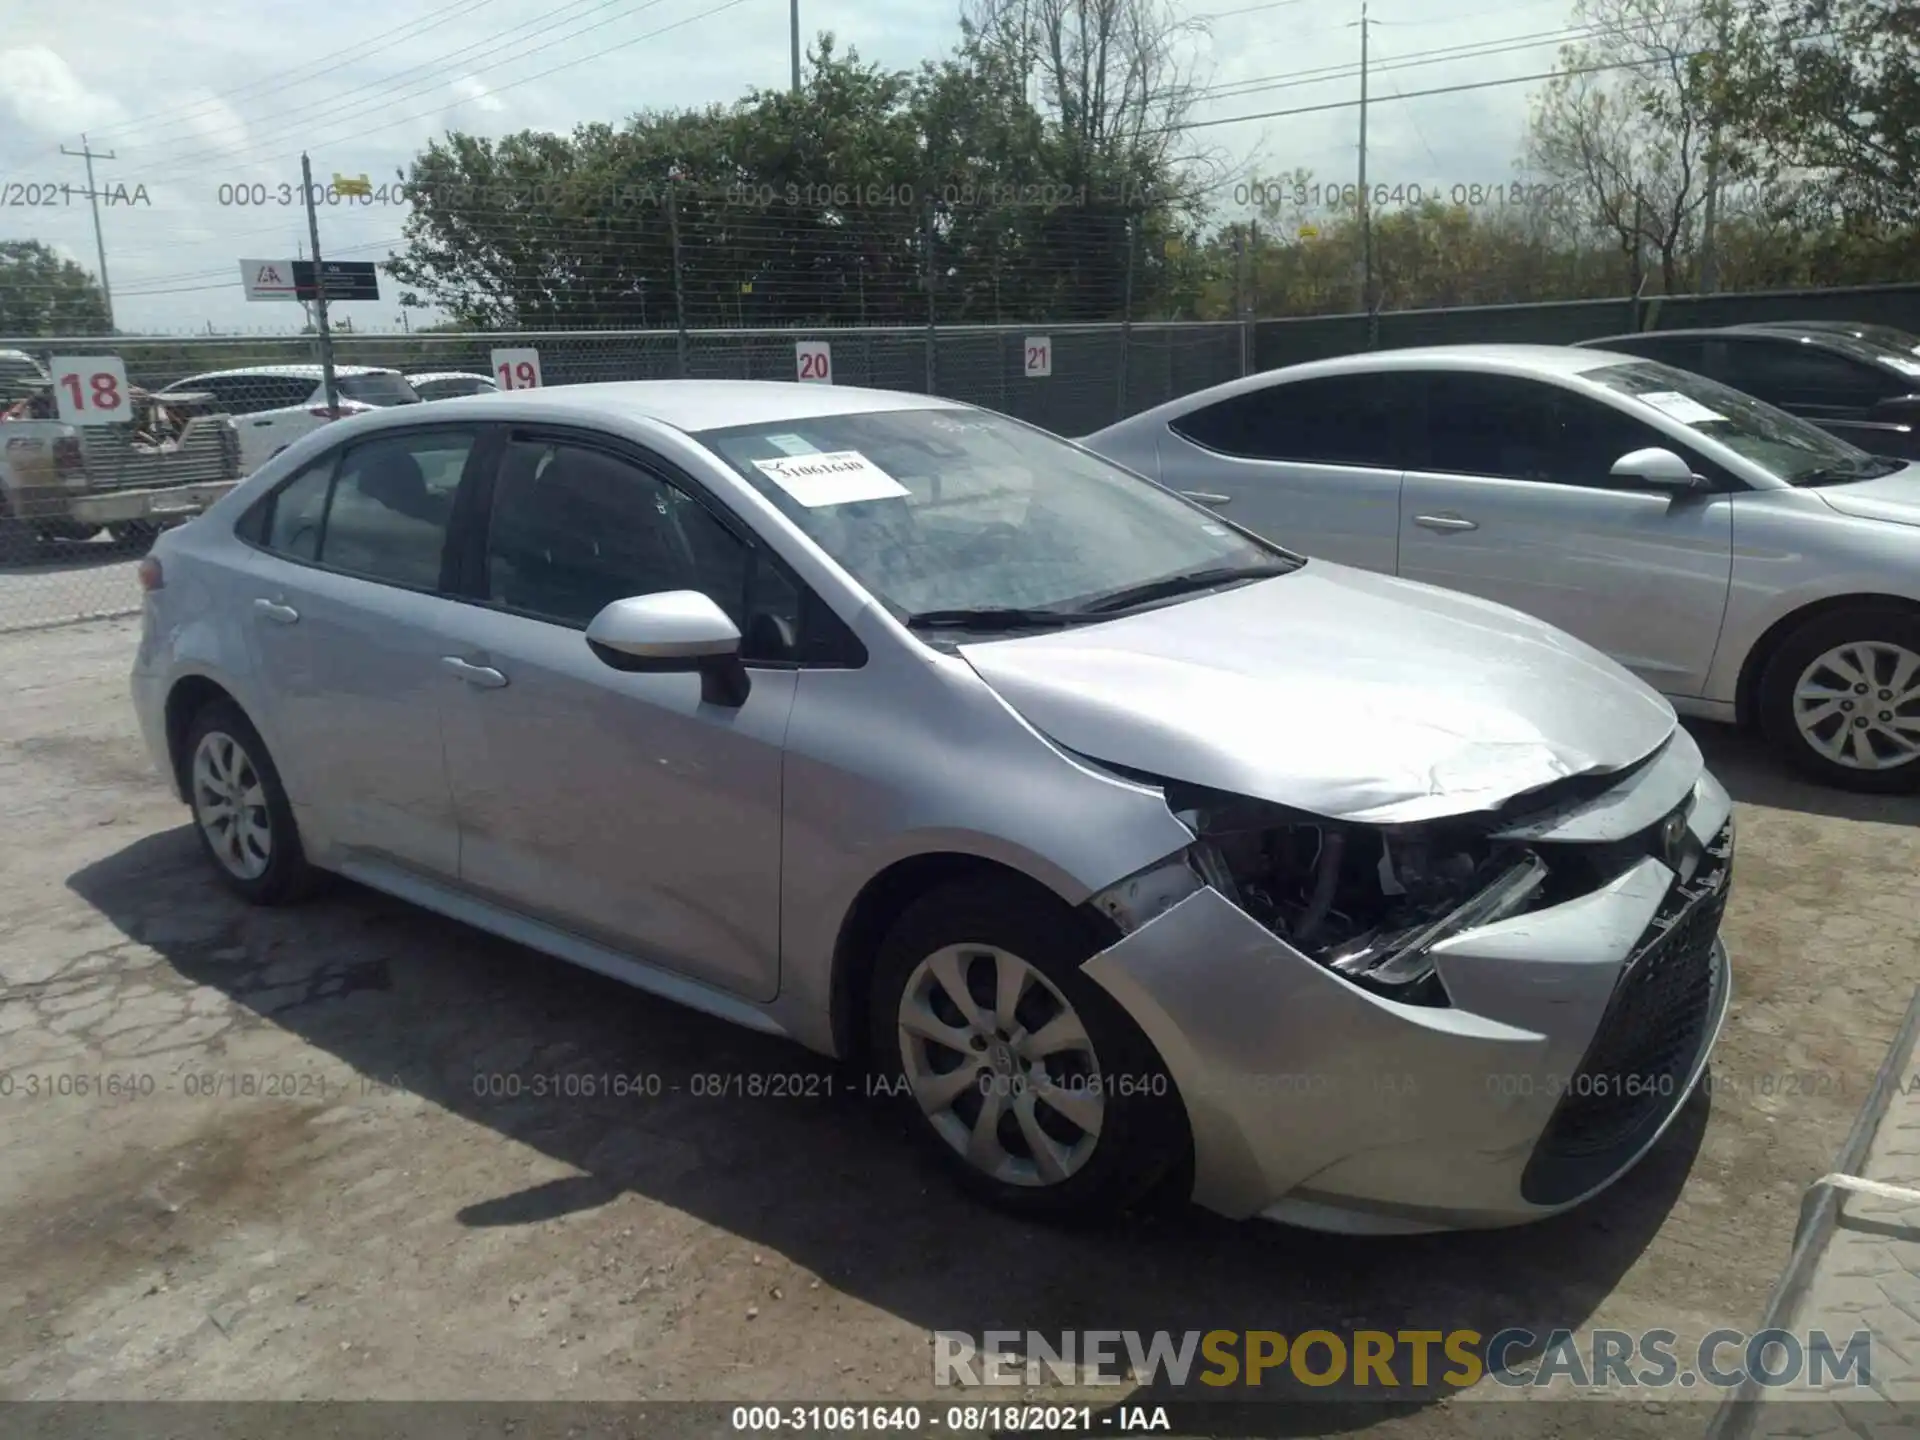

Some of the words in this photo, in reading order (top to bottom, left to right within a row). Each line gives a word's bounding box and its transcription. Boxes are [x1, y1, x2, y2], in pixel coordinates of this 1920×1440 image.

[800, 353, 828, 379] 20
[1027, 347, 1046, 369] 21
[498, 361, 536, 390] 19
[61, 373, 121, 410] 18
